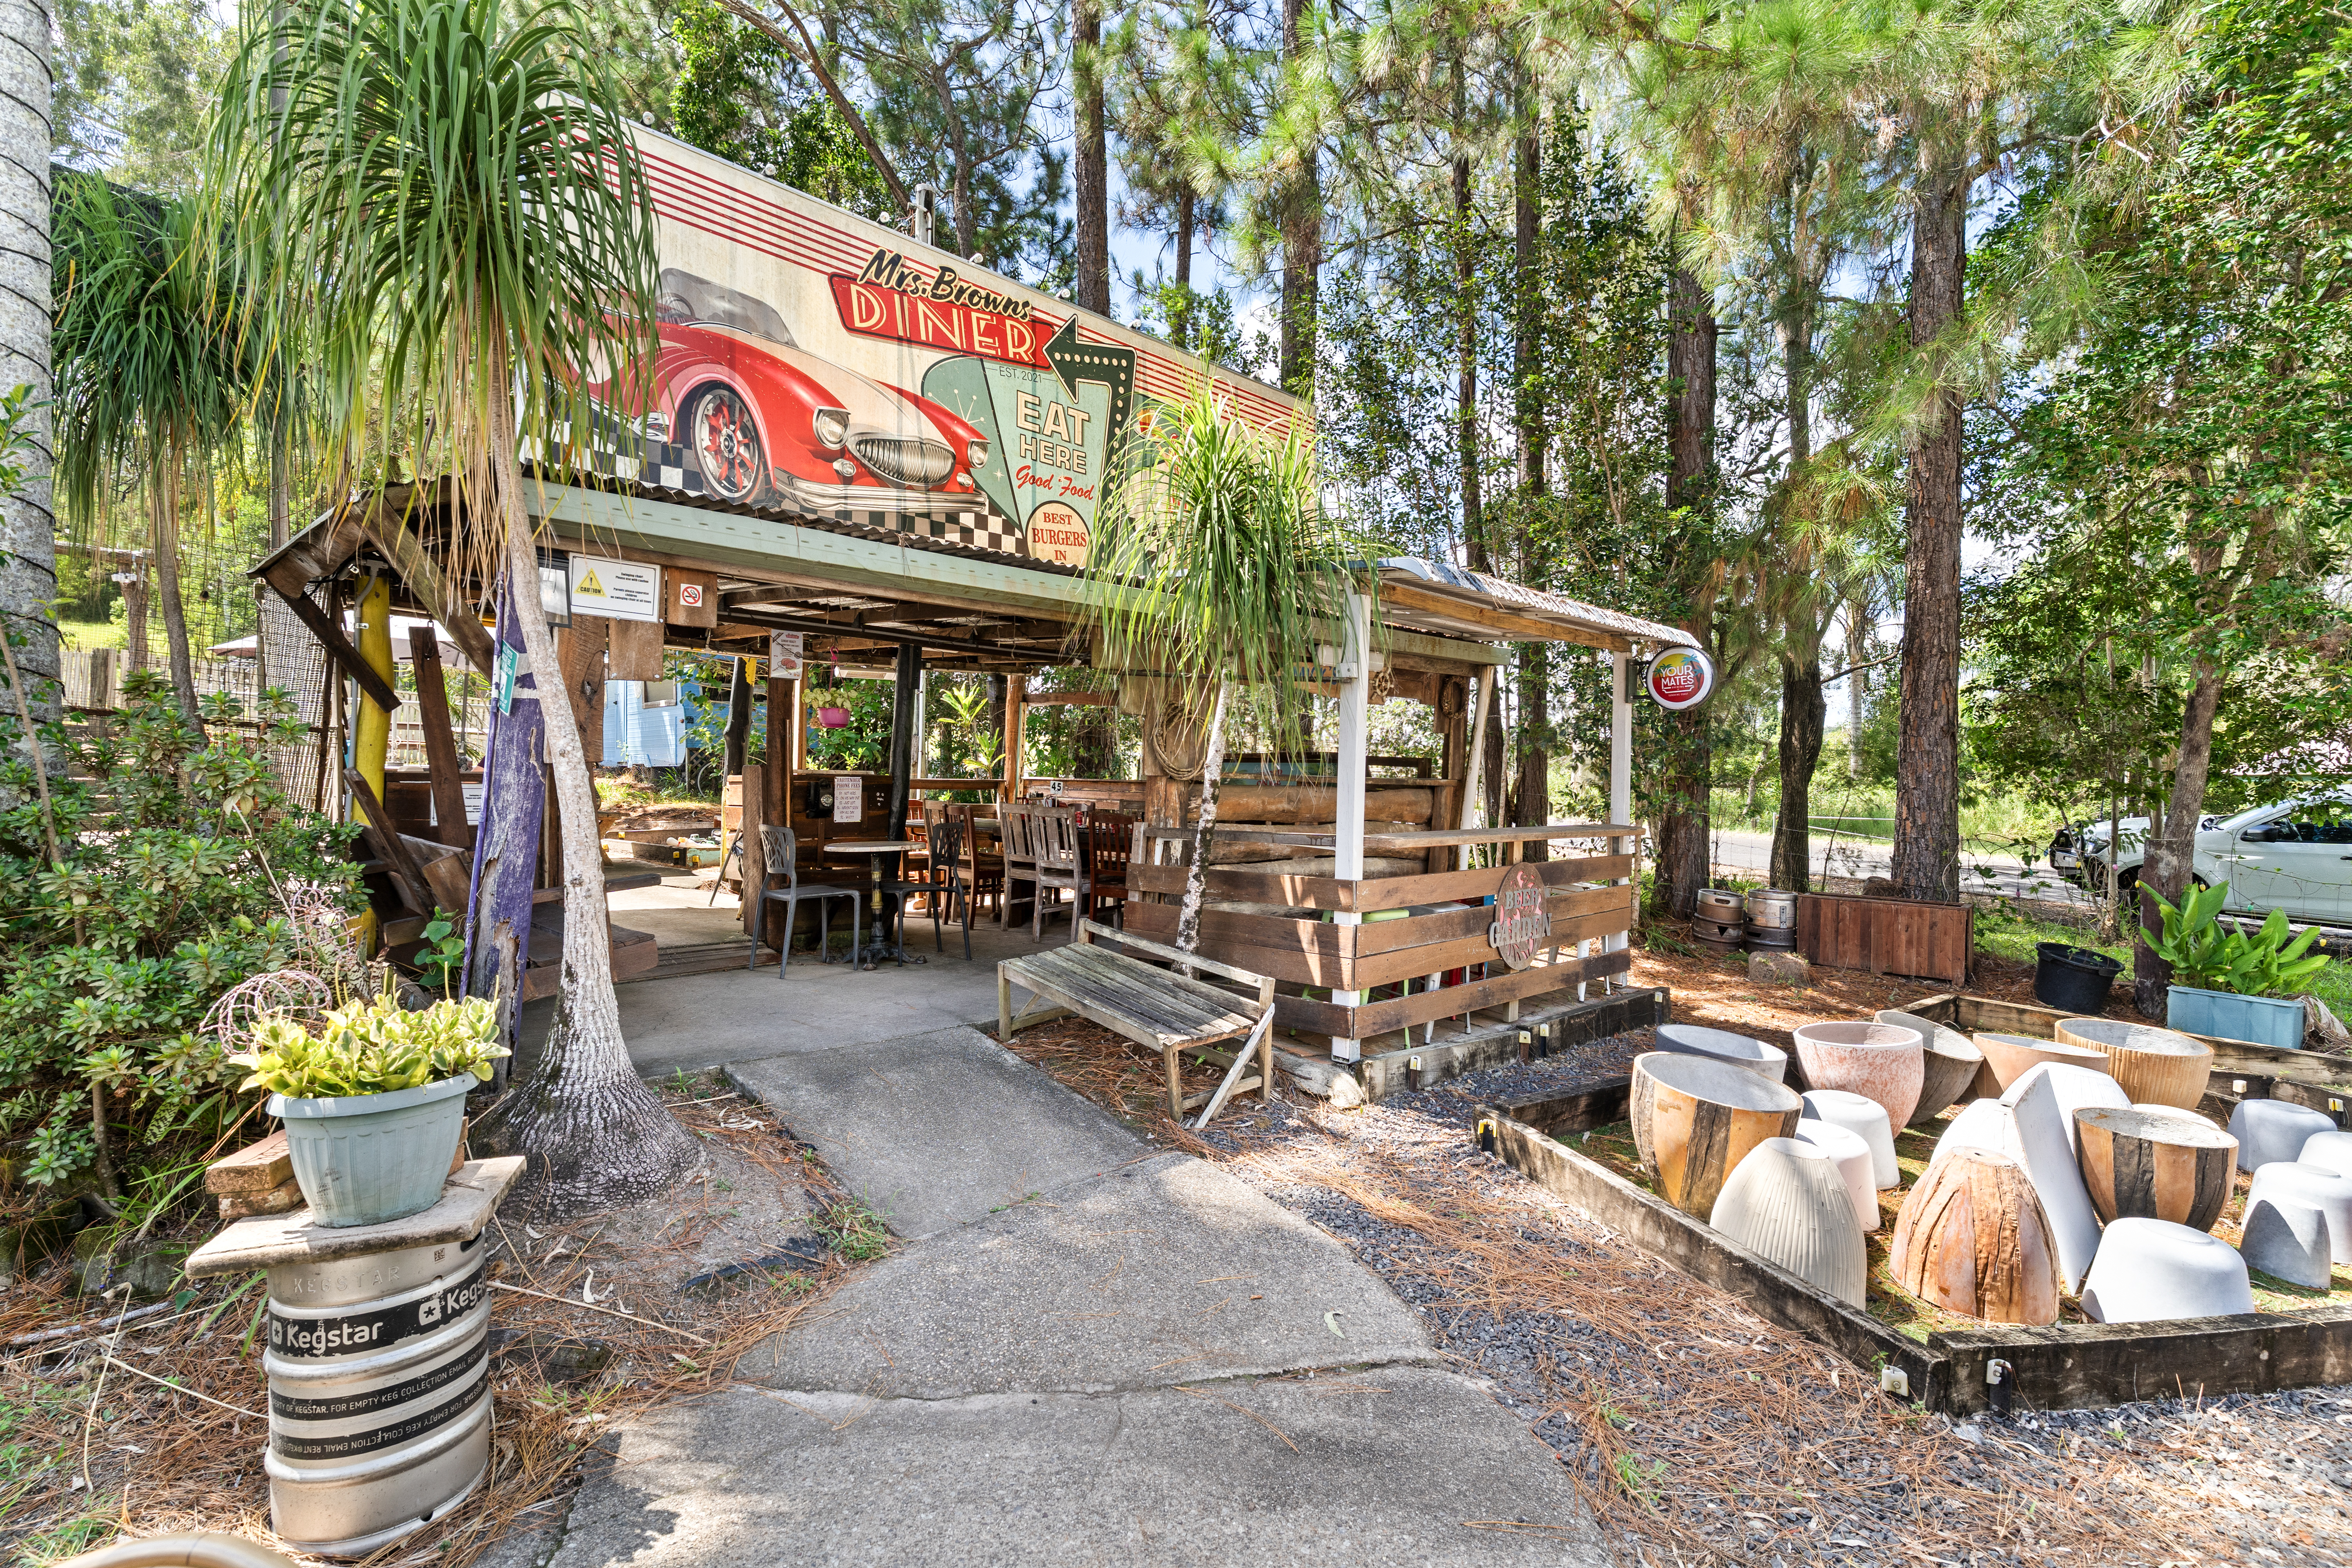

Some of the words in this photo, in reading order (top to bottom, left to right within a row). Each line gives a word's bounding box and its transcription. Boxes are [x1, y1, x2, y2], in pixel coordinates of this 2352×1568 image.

[850, 284, 1036, 363] DINER
[999, 366, 1019, 379] EST.
[1022, 371, 1042, 383] 2021
[1017, 390, 1091, 447] EAT
[1020, 434, 1087, 475] HERE
[1016, 465, 1054, 490] Good
[1058, 476, 1094, 500] Food
[1043, 512, 1073, 525] BEST
[1032, 528, 1087, 547] BURGERS
[1054, 550, 1067, 561] IN
[1661, 665, 1694, 677] YOUR
[1661, 675, 1694, 689] MATES
[1052, 782, 1061, 791] 45
[1505, 888, 1539, 910] BEER
[1490, 913, 1552, 948] GARDEN
[294, 1266, 401, 1293] KEGSTAR
[447, 1269, 487, 1314] Kegst
[287, 1321, 383, 1354] Kegstar
[295, 1405, 328, 1414] KEGSTAR.
[331, 1404, 347, 1412] FOR
[350, 1397, 379, 1410] EMPTY
[382, 1392, 398, 1403] KEG
[401, 1373, 447, 1396] COLLECTION
[449, 1362, 466, 1376] EMAIL
[450, 1400, 462, 1413] FOR
[424, 1408, 448, 1426] EMPTY
[406, 1421, 421, 1433] KEG
[323, 1443, 348, 1452] EMAIL
[351, 1430, 403, 1449] COLLECTION
